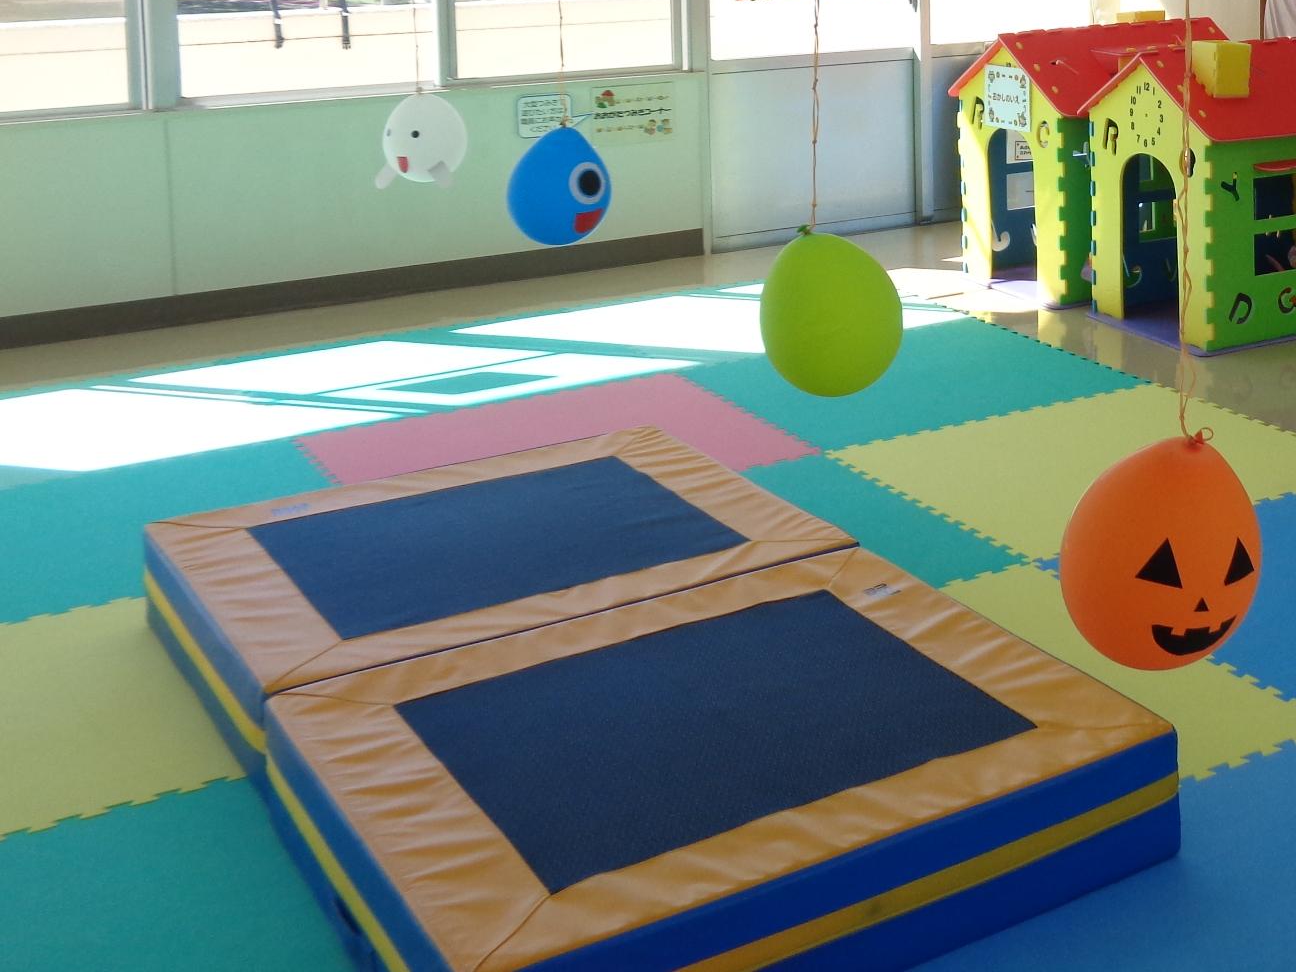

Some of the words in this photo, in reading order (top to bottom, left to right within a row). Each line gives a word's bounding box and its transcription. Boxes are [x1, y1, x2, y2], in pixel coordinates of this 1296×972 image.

[1136, 86, 1141, 95] 11
[1144, 82, 1150, 91] 12
[992, 92, 1020, 104] おかしのいえ
[1130, 96, 1136, 105] 10
[1157, 100, 1162, 109] 2
[1130, 108, 1134, 116] 9
[1160, 114, 1164, 123] 3
[1130, 122, 1134, 130] 8
[1156, 127, 1161, 135] 4
[1136, 134, 1141, 143] 7
[1144, 139, 1147, 147] 6
[1151, 137, 1155, 146] 5
